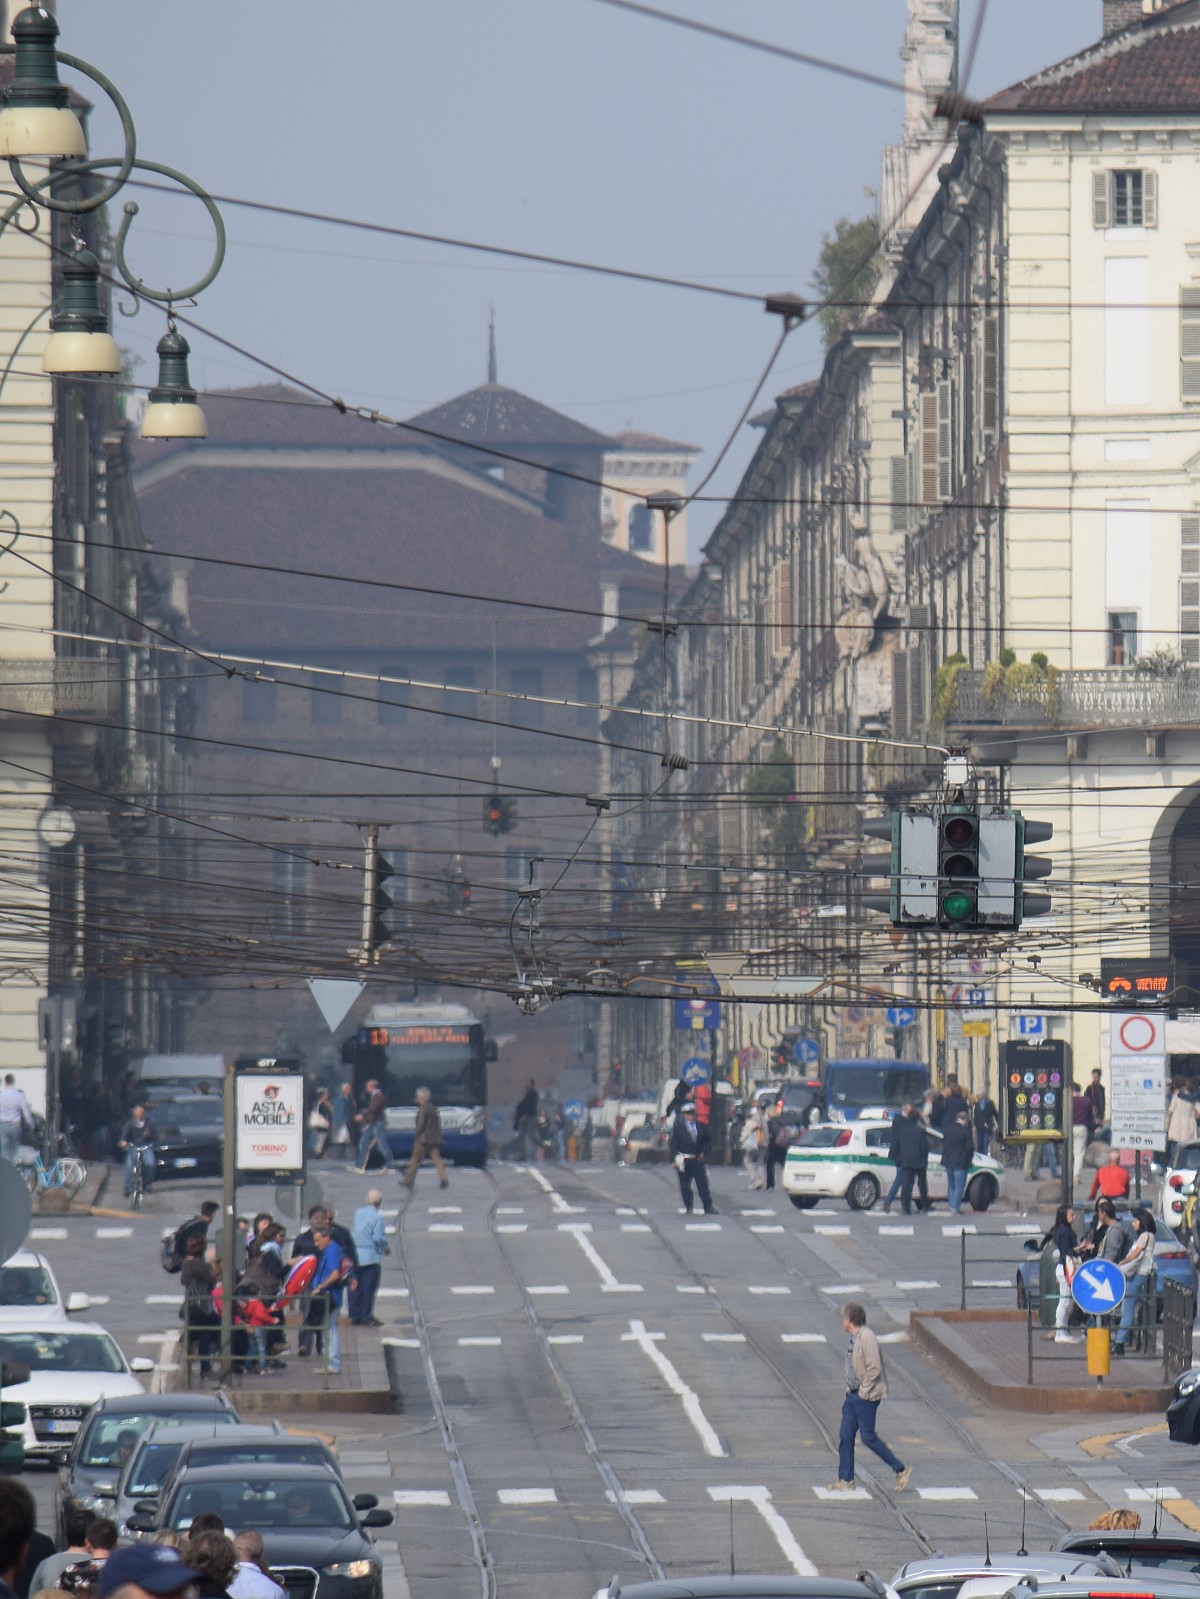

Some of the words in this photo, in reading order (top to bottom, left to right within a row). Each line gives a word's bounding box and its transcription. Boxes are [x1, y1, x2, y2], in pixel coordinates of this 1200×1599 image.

[252, 1101, 286, 1114] ASTA
[244, 1113, 295, 1126] MOBILE
[251, 1144, 288, 1152] TORINO
